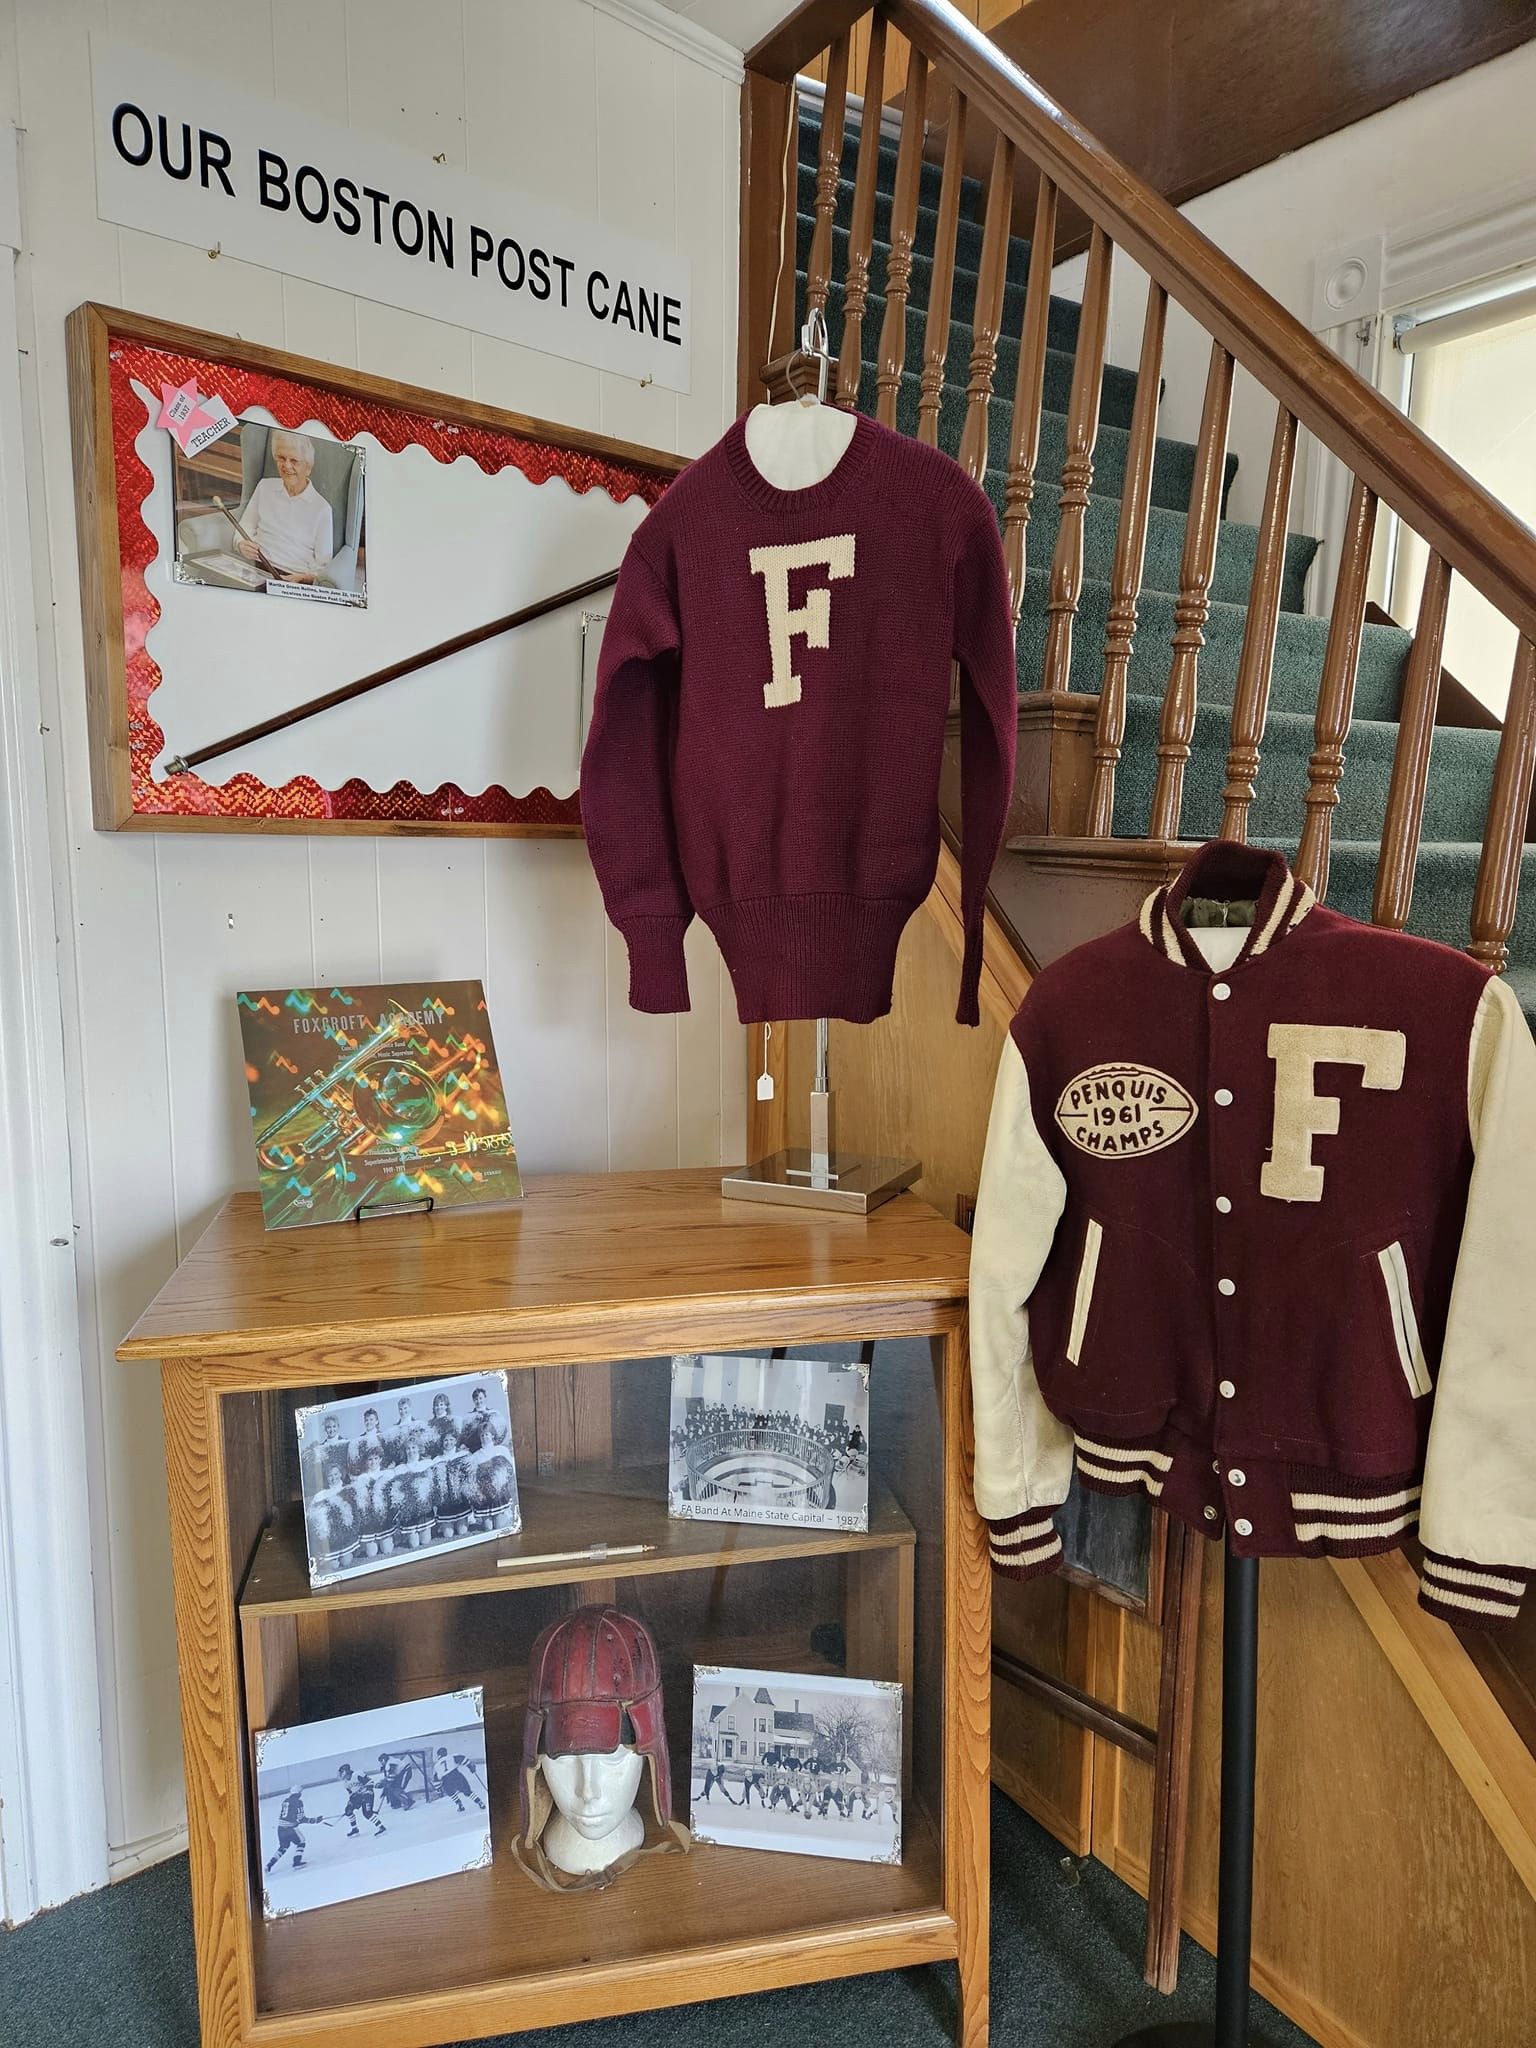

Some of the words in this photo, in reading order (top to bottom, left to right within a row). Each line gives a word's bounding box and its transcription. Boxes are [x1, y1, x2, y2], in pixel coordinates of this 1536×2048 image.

[111, 102, 236, 197] OUR
[258, 149, 454, 269] BOSTON
[470, 226, 575, 308] POST
[587, 270, 682, 346] CANE
[168, 401, 182, 418] Class
[190, 416, 231, 448] TEACHER
[749, 533, 856, 709] F
[293, 1014, 366, 1035] FOXCROFT
[379, 1009, 444, 1030] ACADEMY
[1070, 1080, 1167, 1110] PENQUIS
[1093, 1103, 1141, 1127] 1961
[1260, 1023, 1406, 1202] F
[1076, 1120, 1164, 1152] CHAMPS
[681, 1503, 693, 1514] FA
[694, 1505, 719, 1517] Band
[720, 1506, 732, 1517] At
[734, 1507, 763, 1519] Maine
[764, 1509, 790, 1521] State
[791, 1511, 824, 1524] Capital
[836, 1514, 859, 1526] 1987
